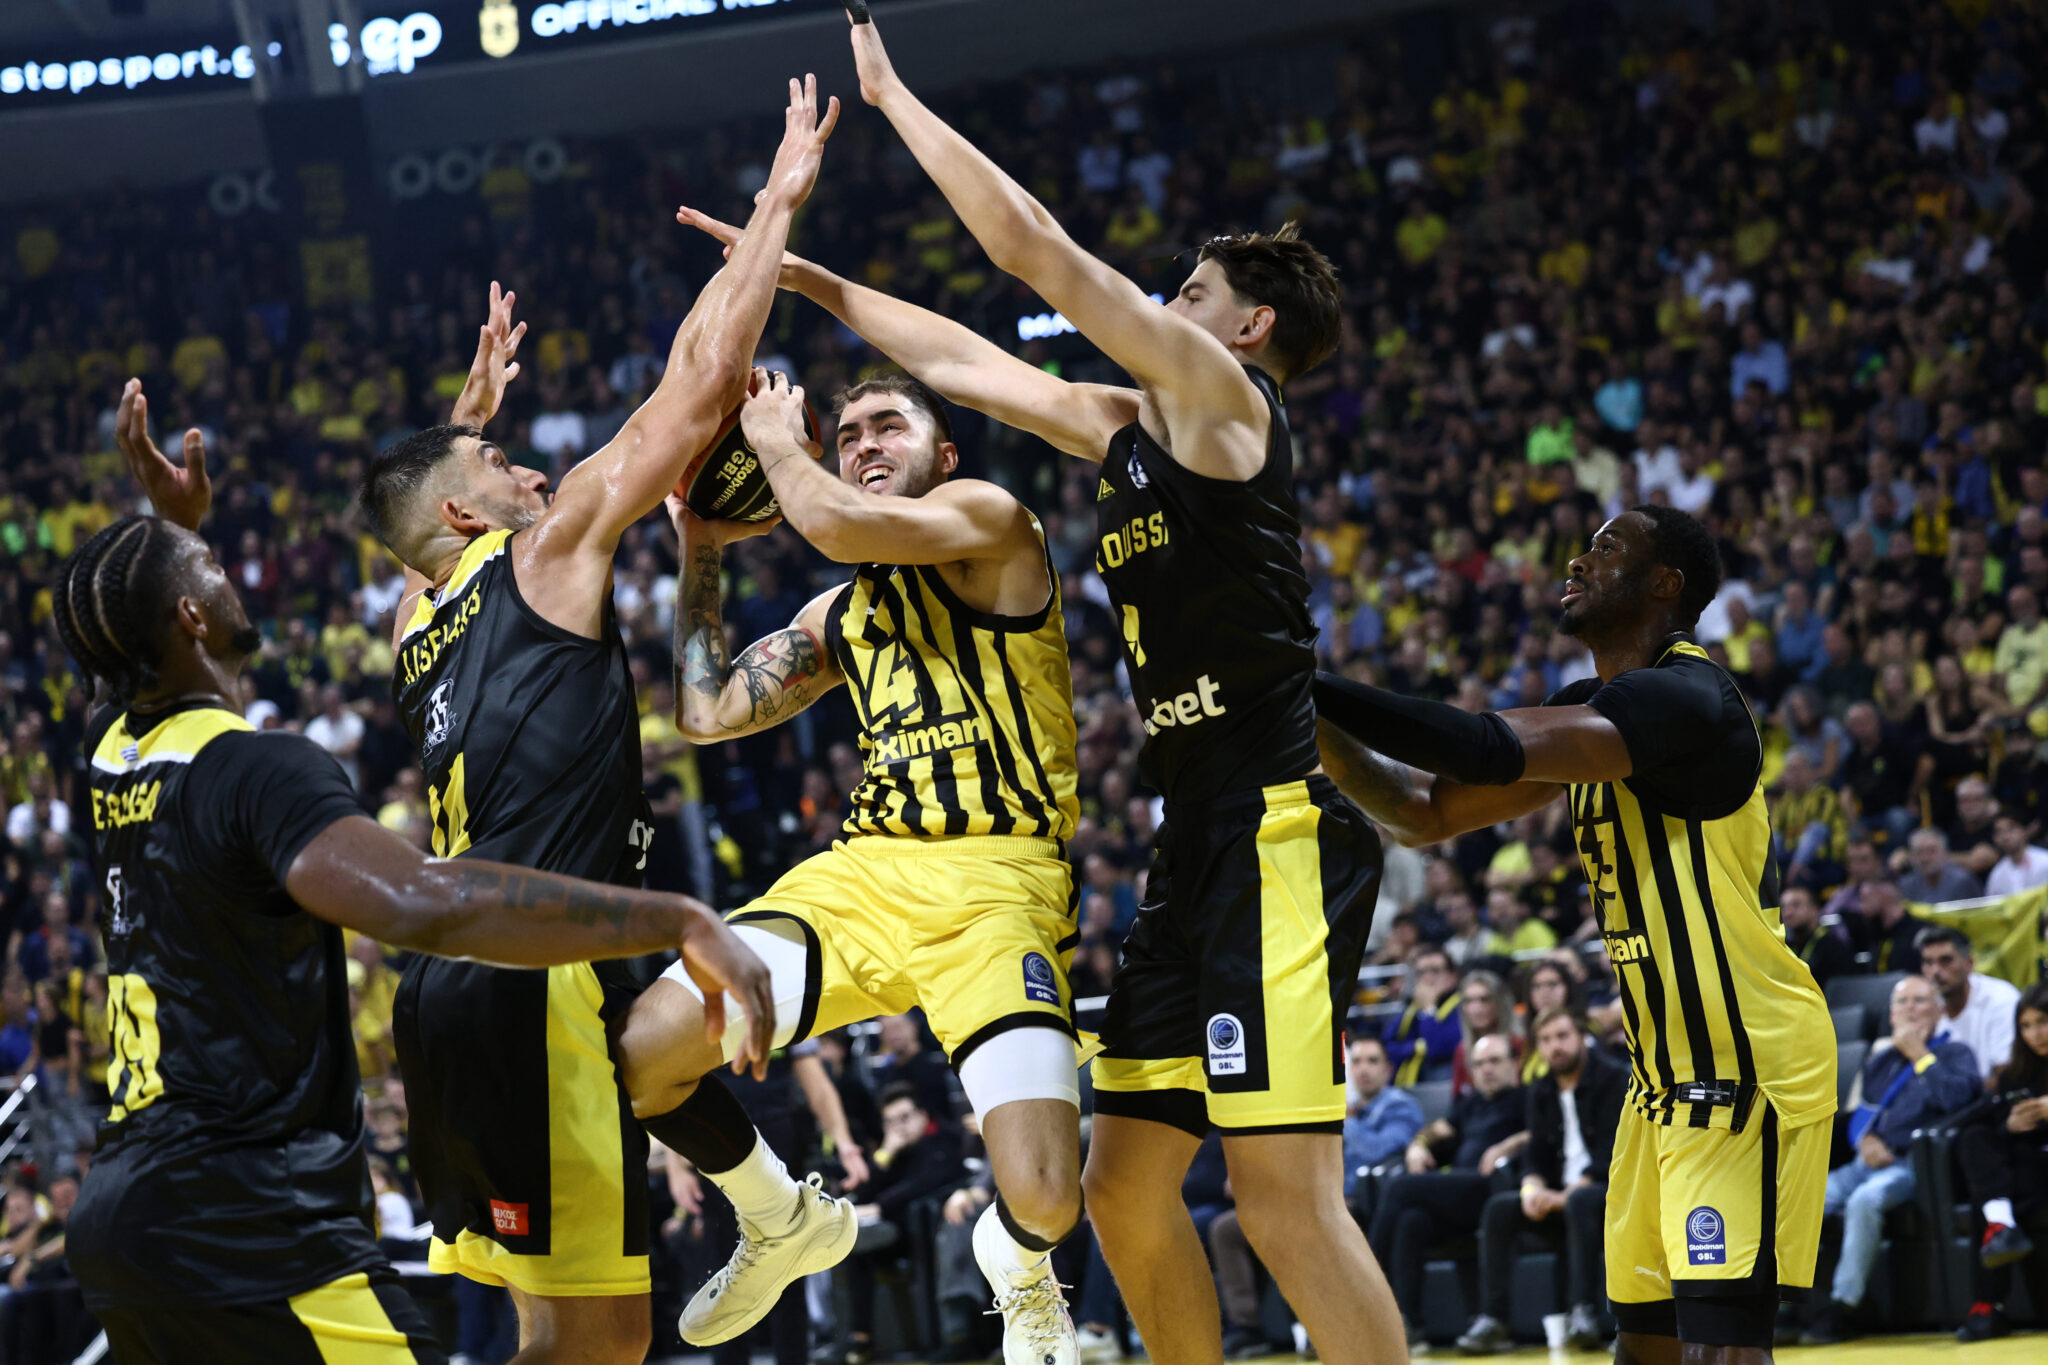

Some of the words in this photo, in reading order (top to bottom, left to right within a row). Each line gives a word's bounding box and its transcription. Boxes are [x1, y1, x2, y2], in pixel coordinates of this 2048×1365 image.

[716, 449, 746, 481] GBL
[874, 716, 989, 764] ximan
[1218, 1061, 1235, 1070] GBL
[1697, 1252, 1716, 1261] GBL
